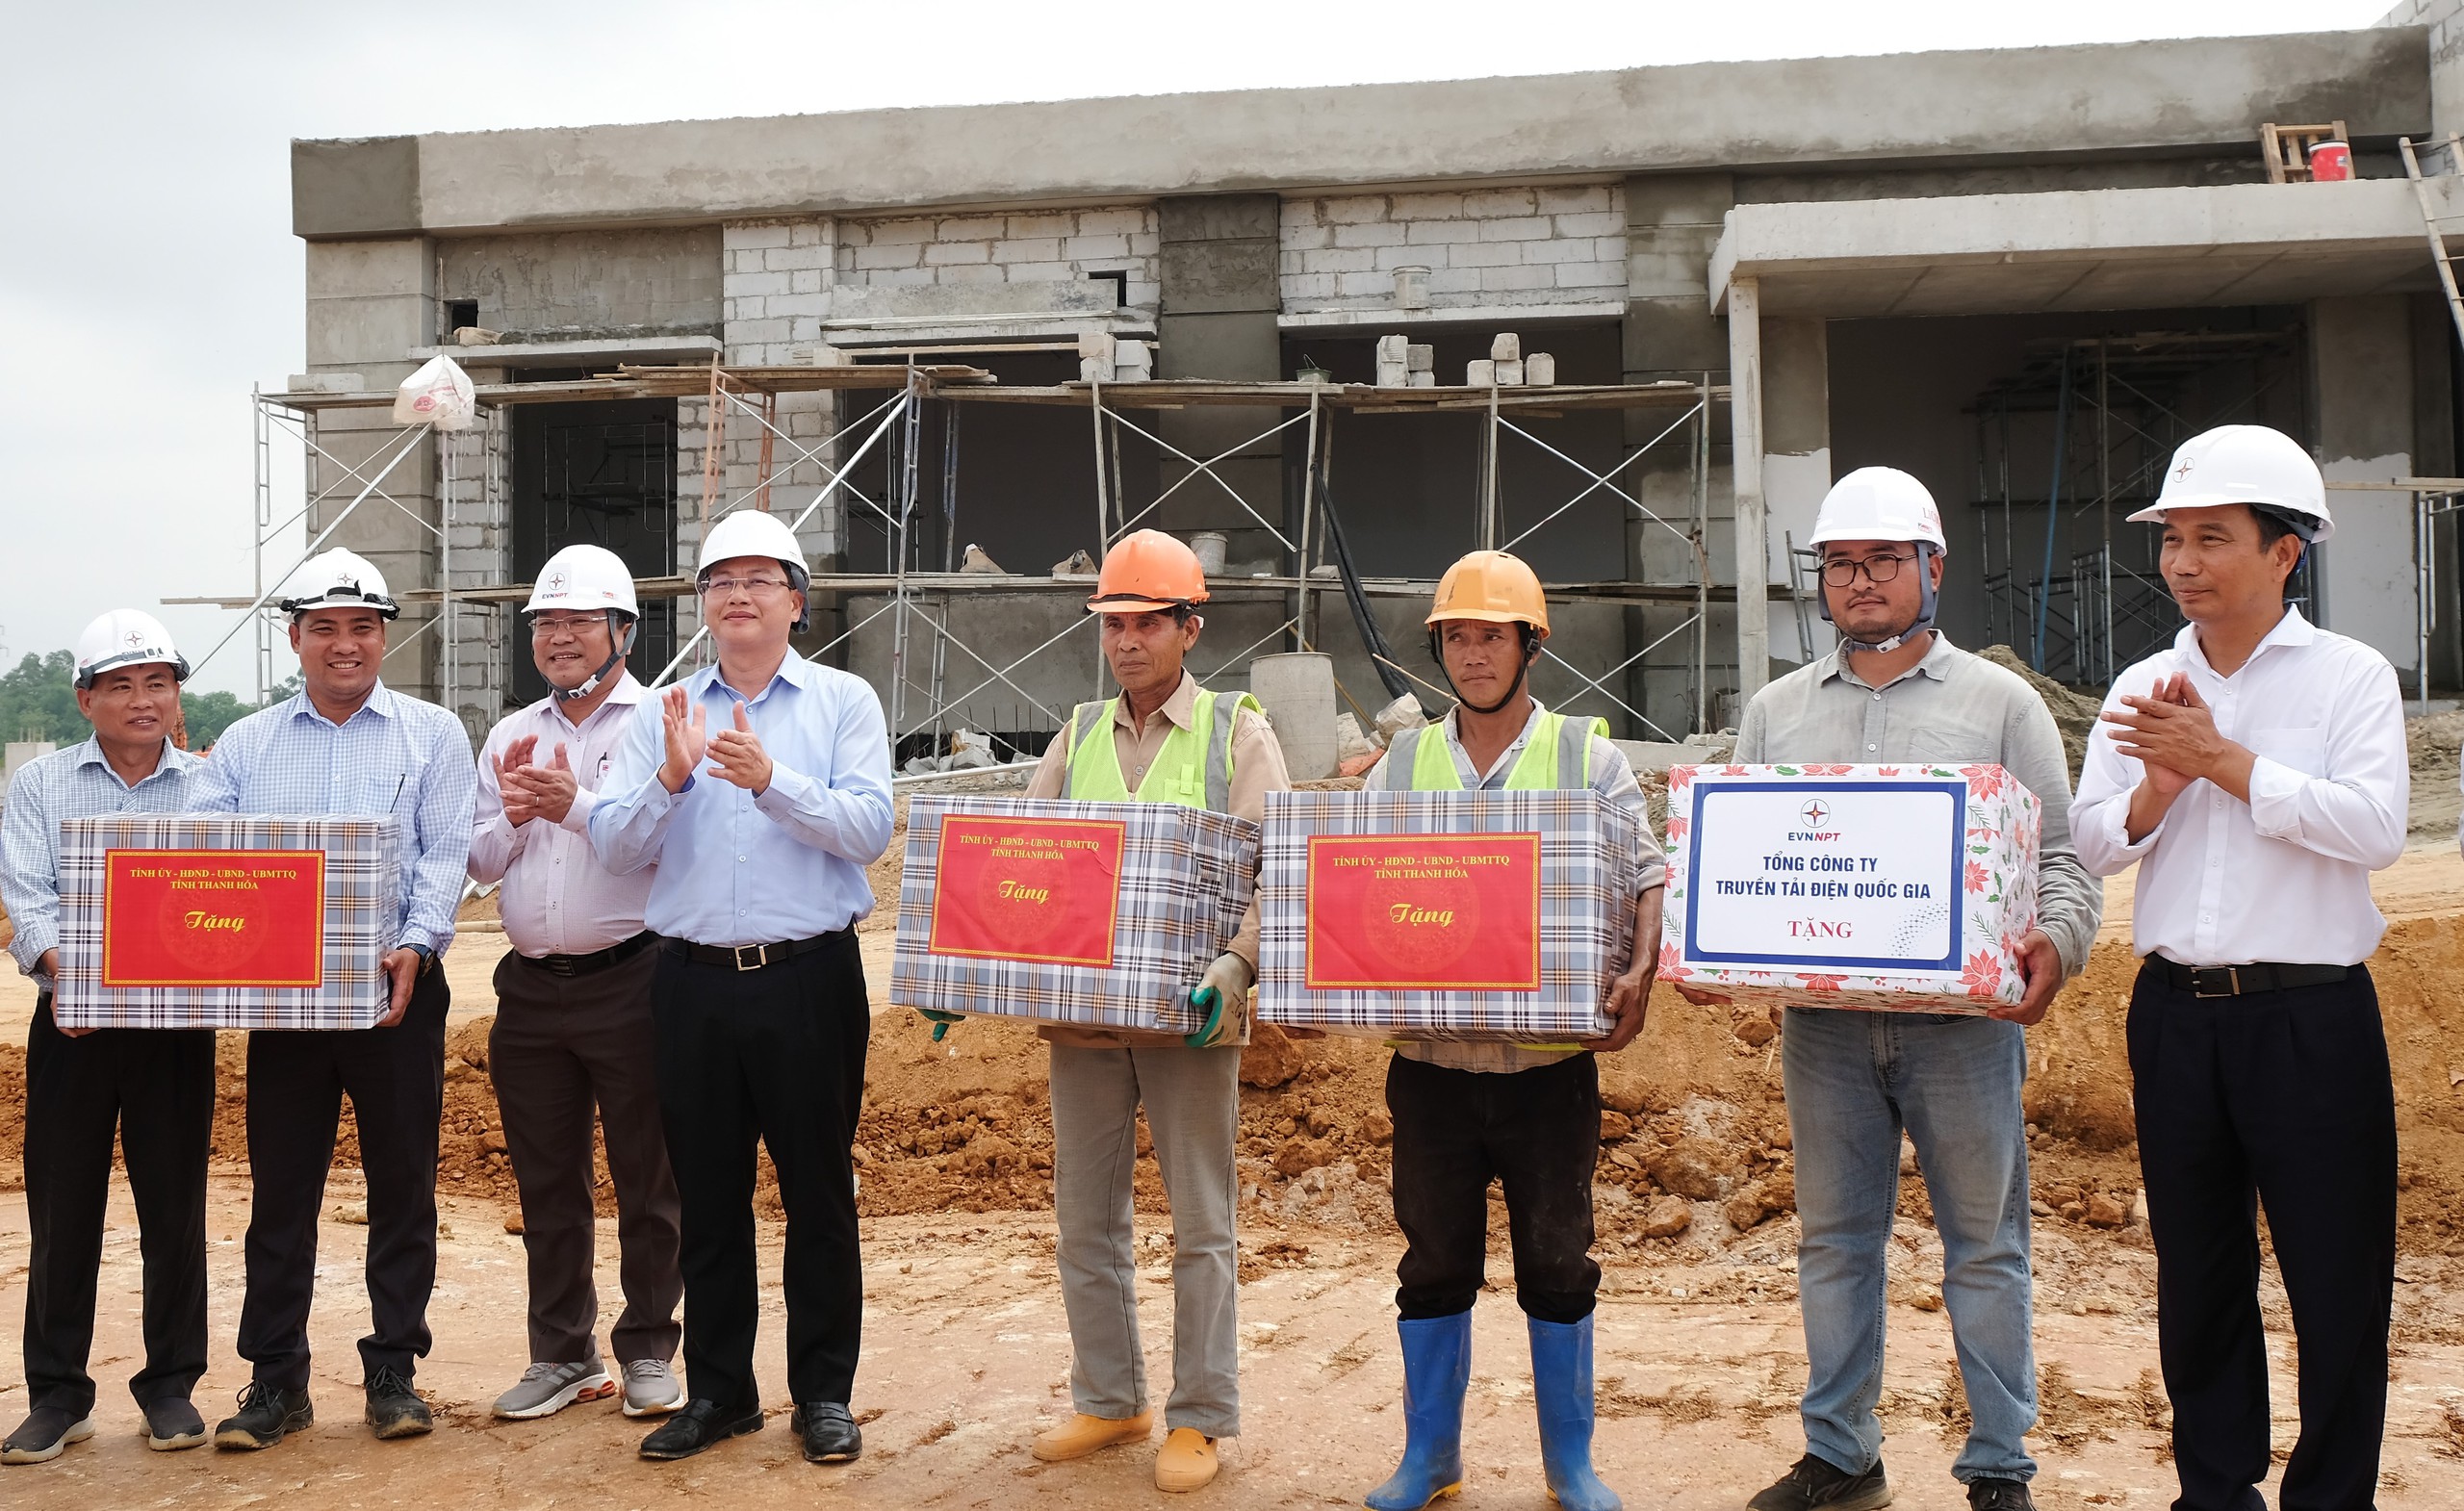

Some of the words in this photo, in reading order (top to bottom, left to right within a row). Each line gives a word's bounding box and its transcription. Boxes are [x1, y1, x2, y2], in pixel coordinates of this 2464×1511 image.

[1000, 837, 1024, 846] HĐND
[1030, 838, 1054, 847] UBND
[1060, 839, 1099, 852] UBMTTQ
[1787, 832, 1841, 842] EVNNPT
[1014, 849, 1043, 859] THANH
[1044, 849, 1064, 859] HÓA
[1384, 857, 1415, 866] HĐND
[1424, 856, 1453, 865] UBND
[1462, 855, 1510, 866] UBMTTQ
[1762, 850, 1805, 872] TỔNG
[1810, 854, 1855, 872] CÔNG
[1860, 858, 1879, 872] TY
[179, 869, 210, 878] HĐND
[217, 869, 245, 879] UBND
[252, 869, 297, 880] UBMTTQ
[1403, 869, 1442, 879] THANH
[1445, 866, 1469, 879] HÓA
[198, 881, 234, 889] THANH
[237, 879, 259, 890] HÓA
[1716, 876, 1776, 896] TRUYỀN
[1781, 877, 1806, 897] TẢI
[1810, 879, 1849, 901] ĐIỆN
[1854, 878, 1898, 900] QUỐC
[1903, 884, 1931, 899] GIA
[998, 880, 1050, 905] Tặng
[184, 910, 246, 933] Tặng
[1389, 903, 1455, 928] Tặng
[1786, 916, 1854, 941] TẶNG
